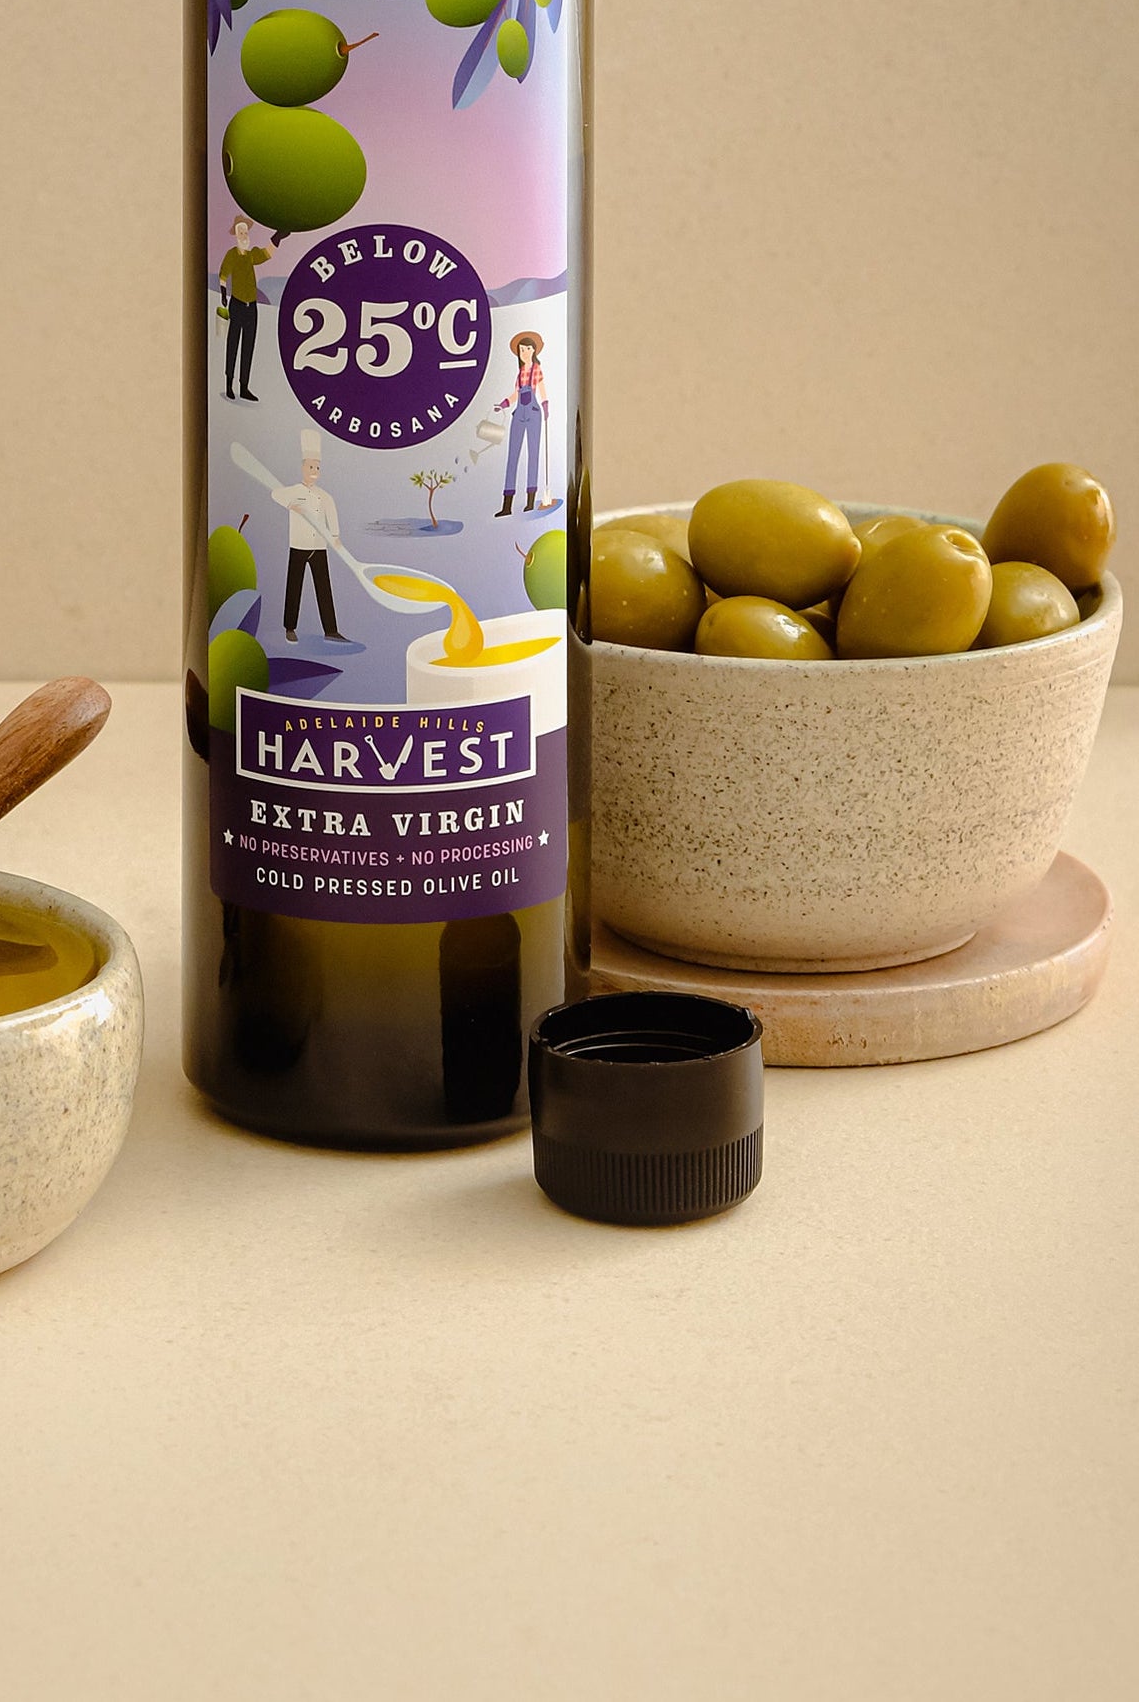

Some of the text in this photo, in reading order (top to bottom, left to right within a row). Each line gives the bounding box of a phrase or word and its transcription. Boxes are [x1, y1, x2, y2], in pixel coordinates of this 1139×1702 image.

[310, 235, 457, 282] BELOW
[312, 393, 459, 437] ARBOSANA
[284, 715, 485, 734] ADELAIDE HILLS
[257, 730, 514, 780] HARVEST
[250, 798, 525, 837] EXTRA VIRGIN
[239, 834, 257, 852] NO
[261, 840, 390, 867] PRESERVATIVES
[411, 850, 434, 866] NO
[440, 835, 533, 863] PROCESSING
[256, 867, 520, 896] COLD PRESSED OLIVE OIL
